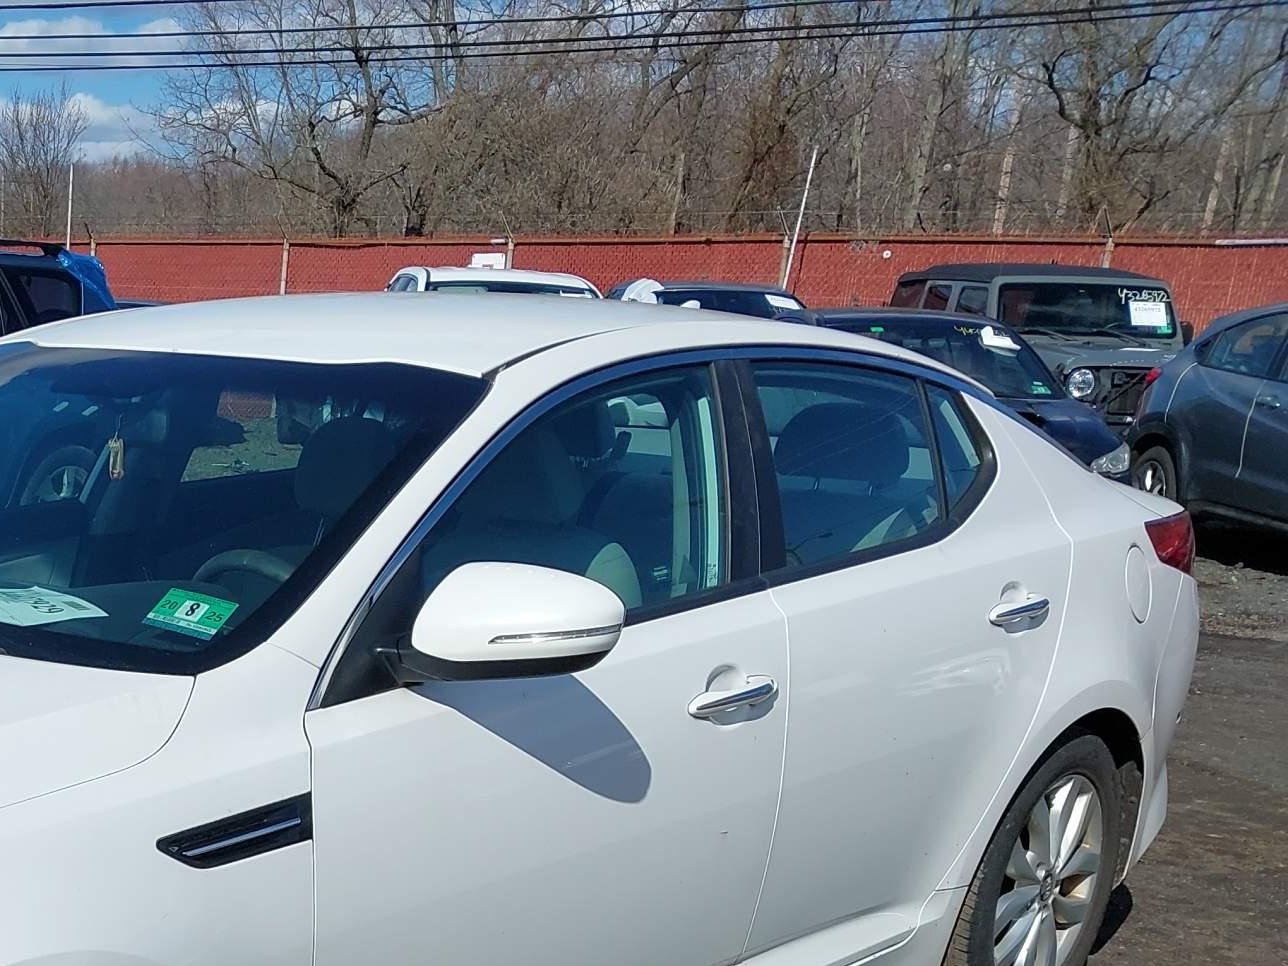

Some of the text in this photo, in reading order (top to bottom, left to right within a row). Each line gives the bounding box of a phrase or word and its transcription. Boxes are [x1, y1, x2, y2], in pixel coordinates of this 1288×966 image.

[160, 599, 225, 623] 20 8 25
